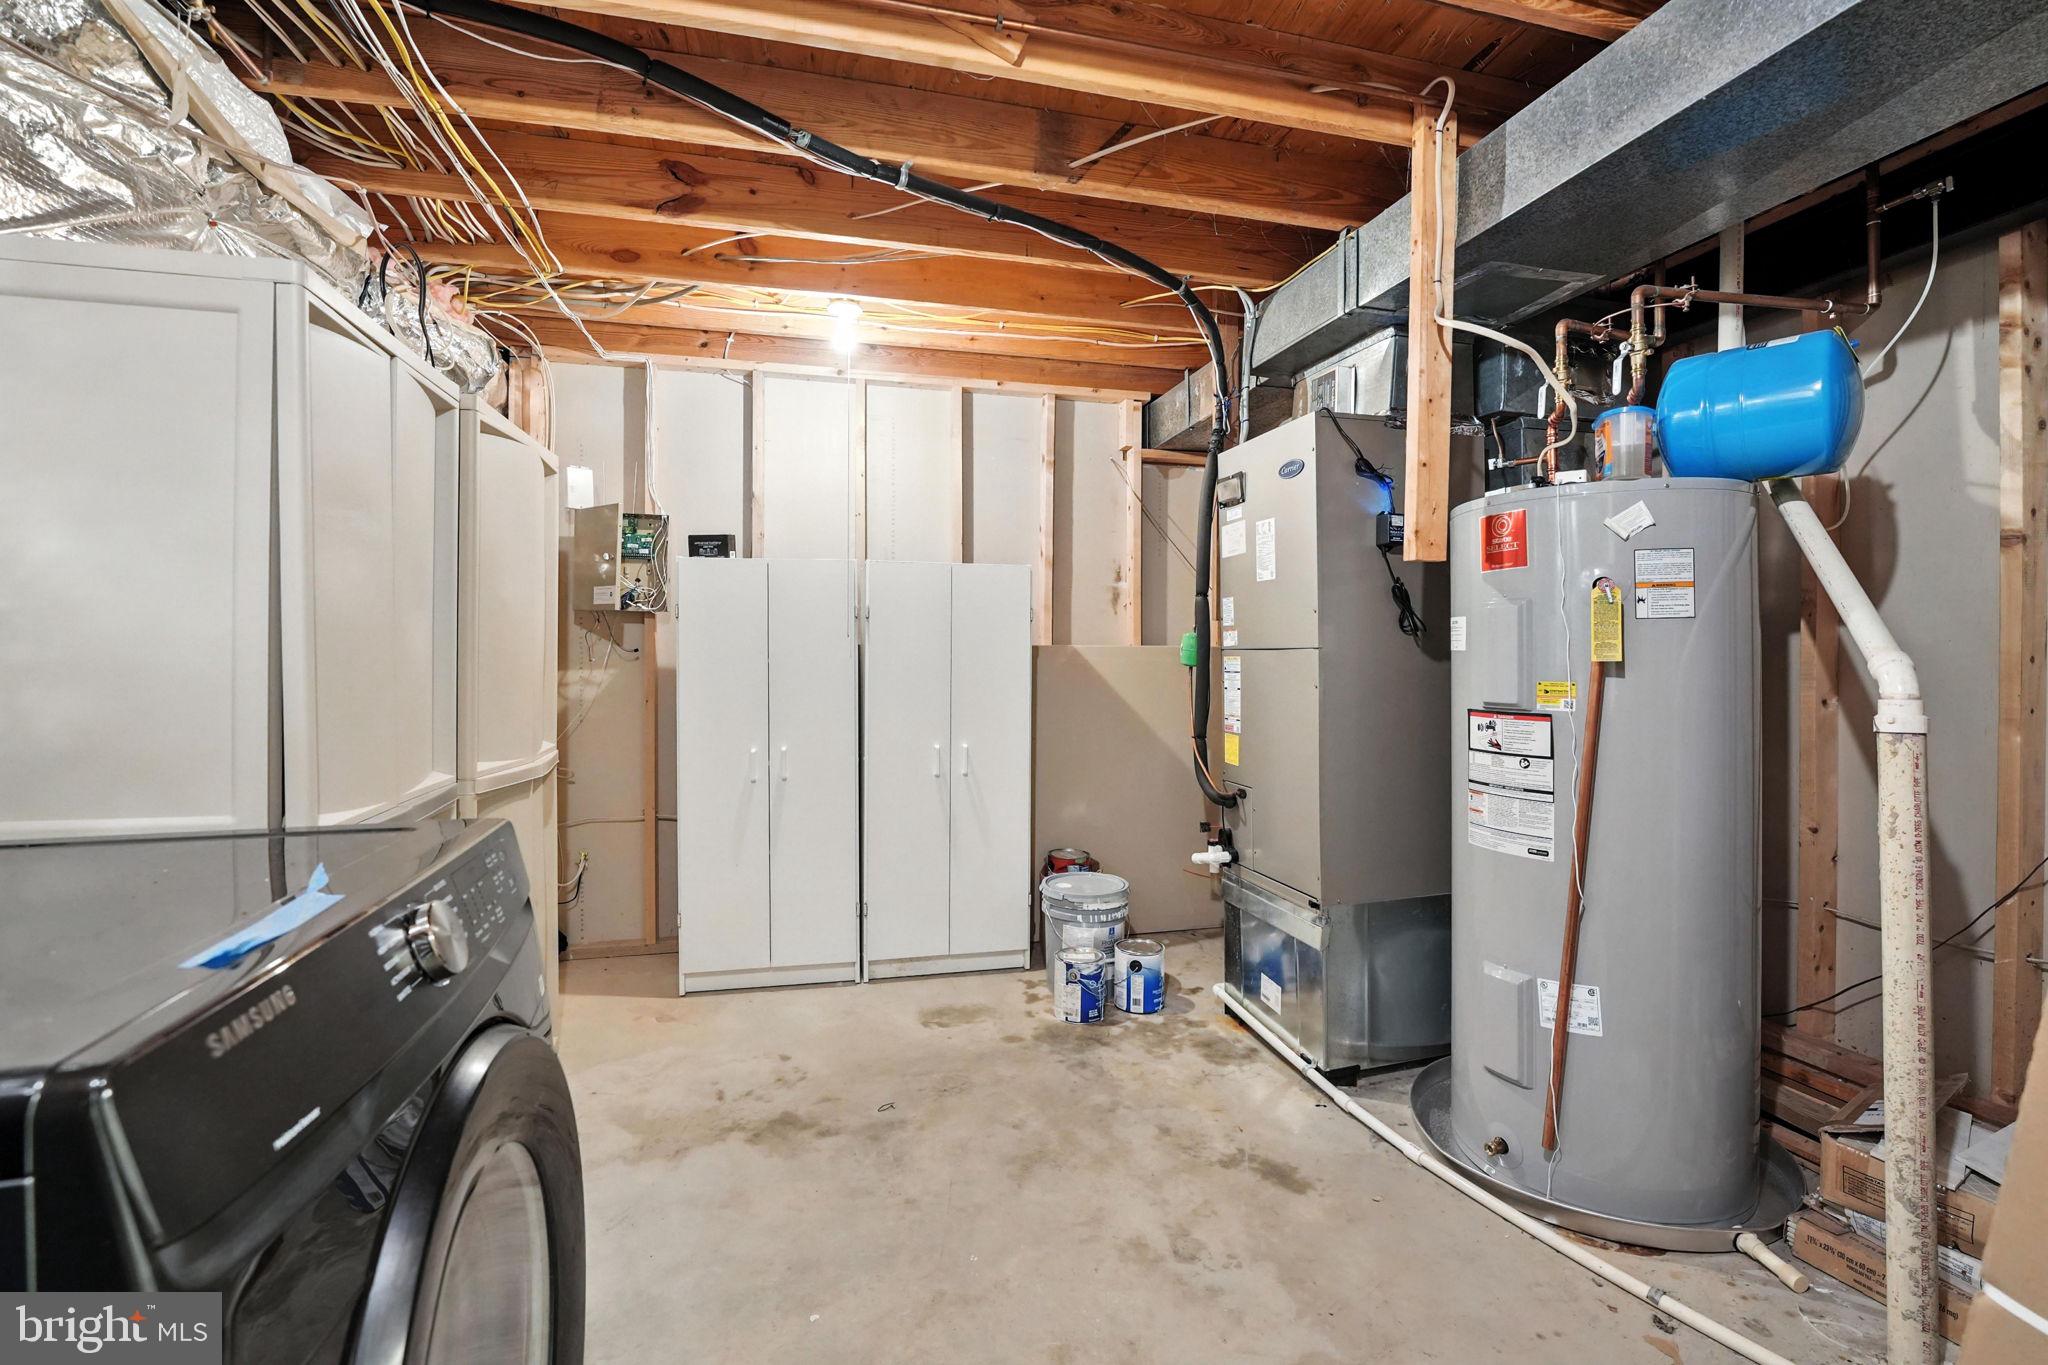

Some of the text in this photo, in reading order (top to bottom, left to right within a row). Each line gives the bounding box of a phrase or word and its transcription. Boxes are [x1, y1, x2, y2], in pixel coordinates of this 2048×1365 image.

[1487, 542, 1520, 552] SELECT
[1913, 790, 1922, 818] CHARLOTTE
[1914, 840, 1923, 854] ASTM
[1914, 865, 1924, 891] SCHEDULE
[205, 984, 297, 1058] SAMSUNG
[1846, 1256, 1854, 1265] cm
[1859, 1262, 1866, 1271] 60
